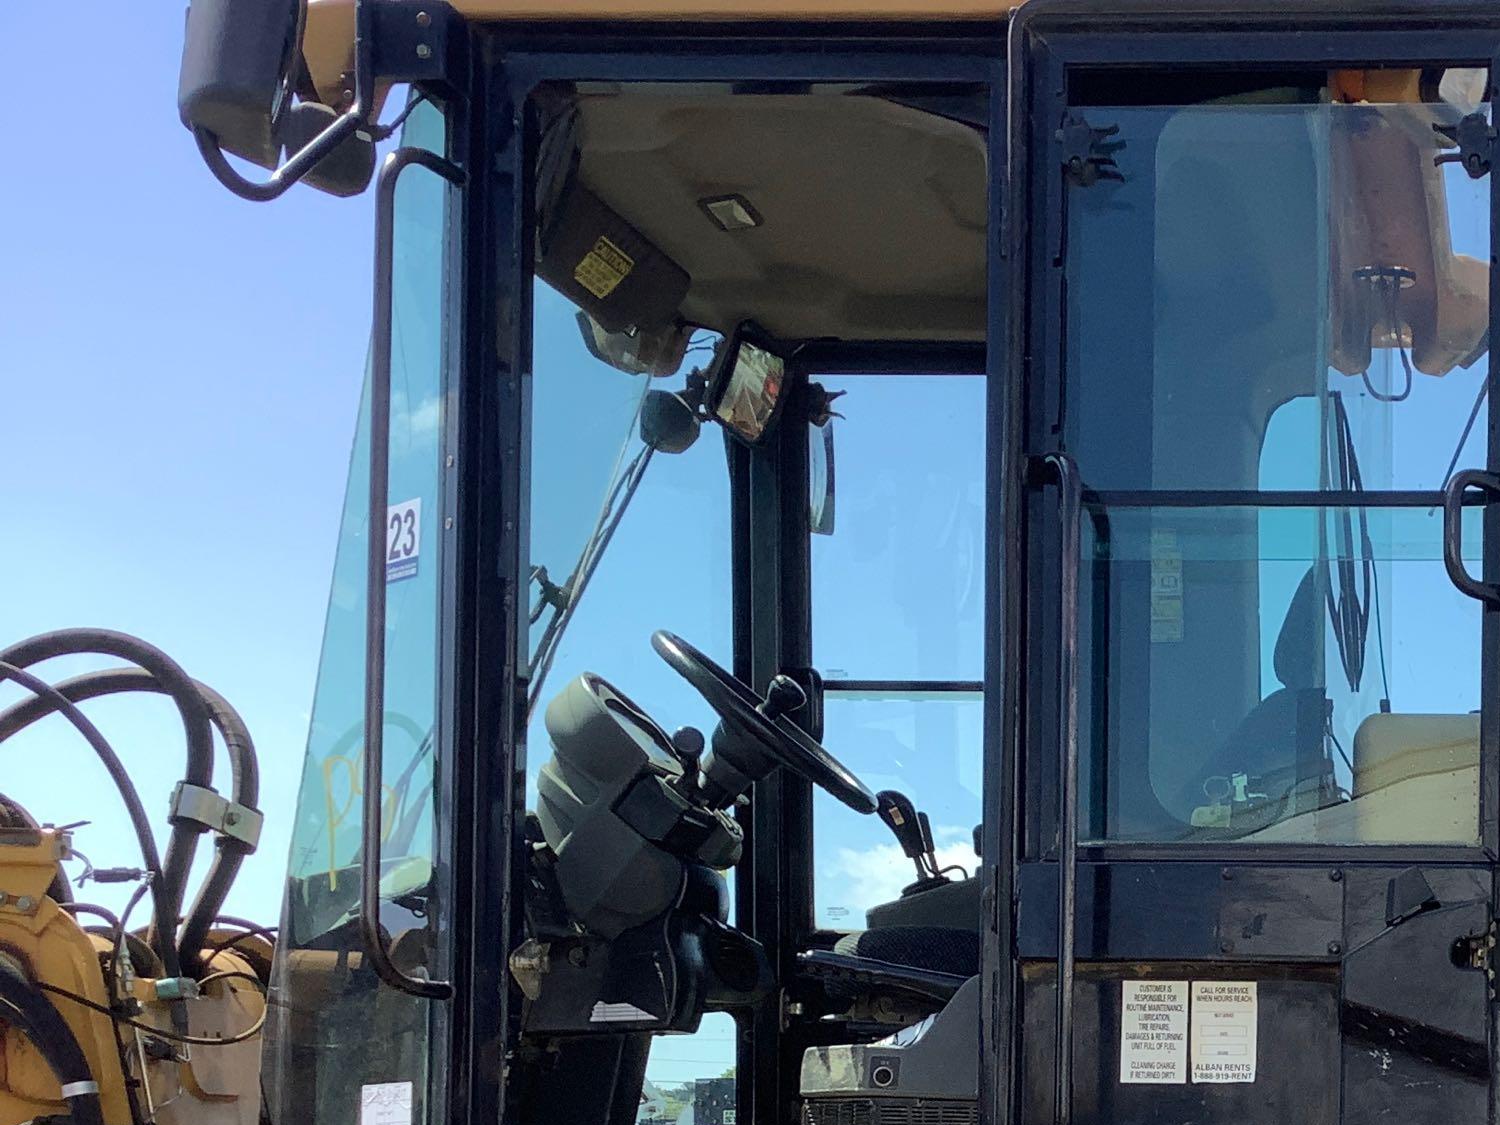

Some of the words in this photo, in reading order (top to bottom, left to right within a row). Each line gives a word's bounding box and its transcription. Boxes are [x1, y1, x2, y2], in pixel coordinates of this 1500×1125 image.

[389, 508, 416, 561] 23
[1134, 994, 1166, 1002] RESPONSIBLE
[1131, 1042, 1143, 1050] UNIT
[1144, 1042, 1155, 1050] FULL
[1156, 1042, 1163, 1050] OF
[1194, 1072, 1252, 1080] 1-888-919-RENT
